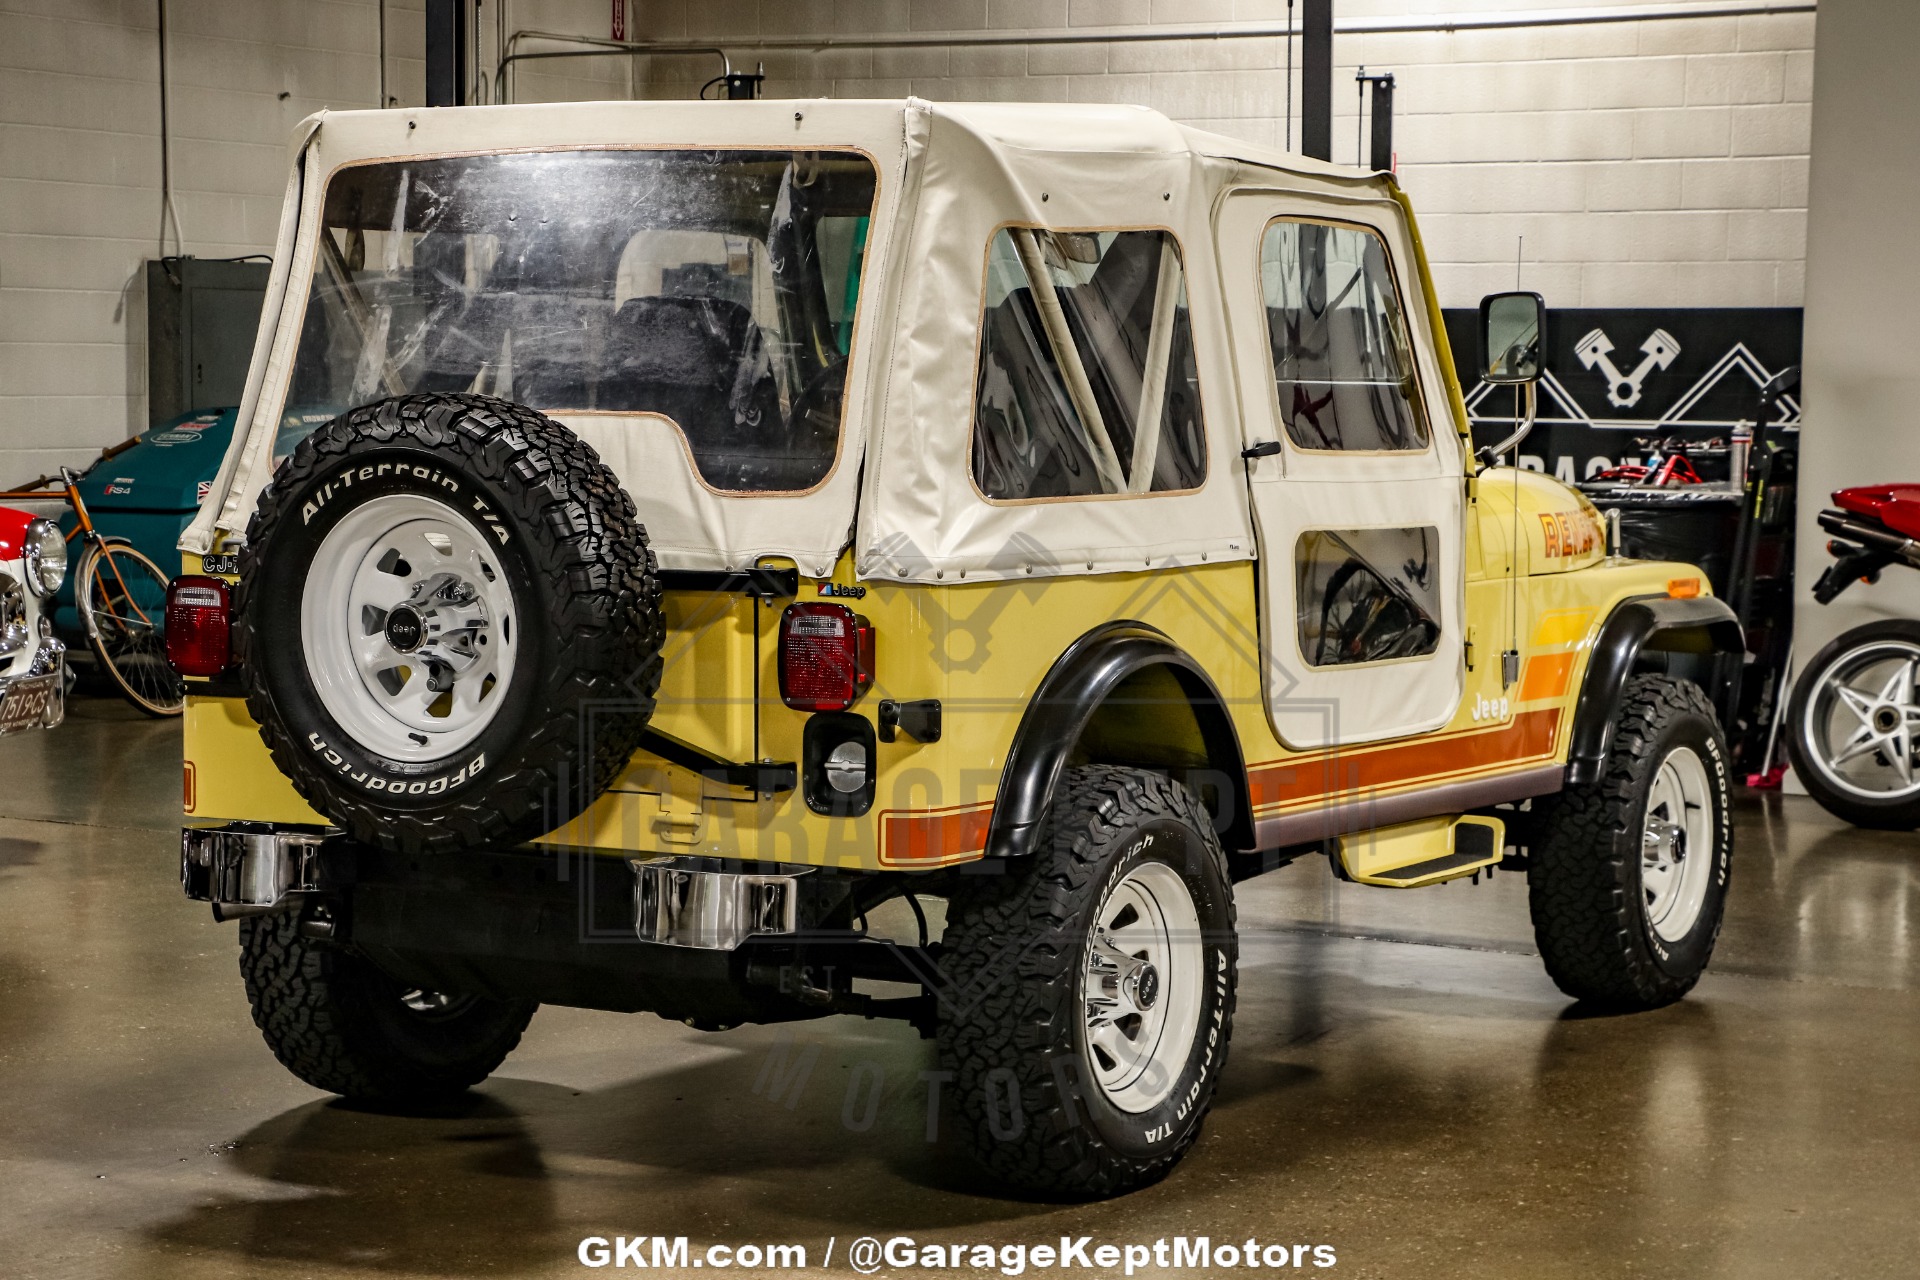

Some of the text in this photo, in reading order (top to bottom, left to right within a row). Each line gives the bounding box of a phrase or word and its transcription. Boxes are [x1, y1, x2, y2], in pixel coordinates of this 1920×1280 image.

[104, 484, 132, 495] RS4
[302, 462, 510, 546] All-Terrain T/A
[833, 583, 866, 600] Jeep
[392, 623, 416, 637] Jeep
[1471, 692, 1508, 721] Jeep
[308, 731, 486, 795] BFGoodrich
[1705, 736, 1730, 887] BFGoodrich
[1144, 948, 1228, 1145] All-Terrain T/A
